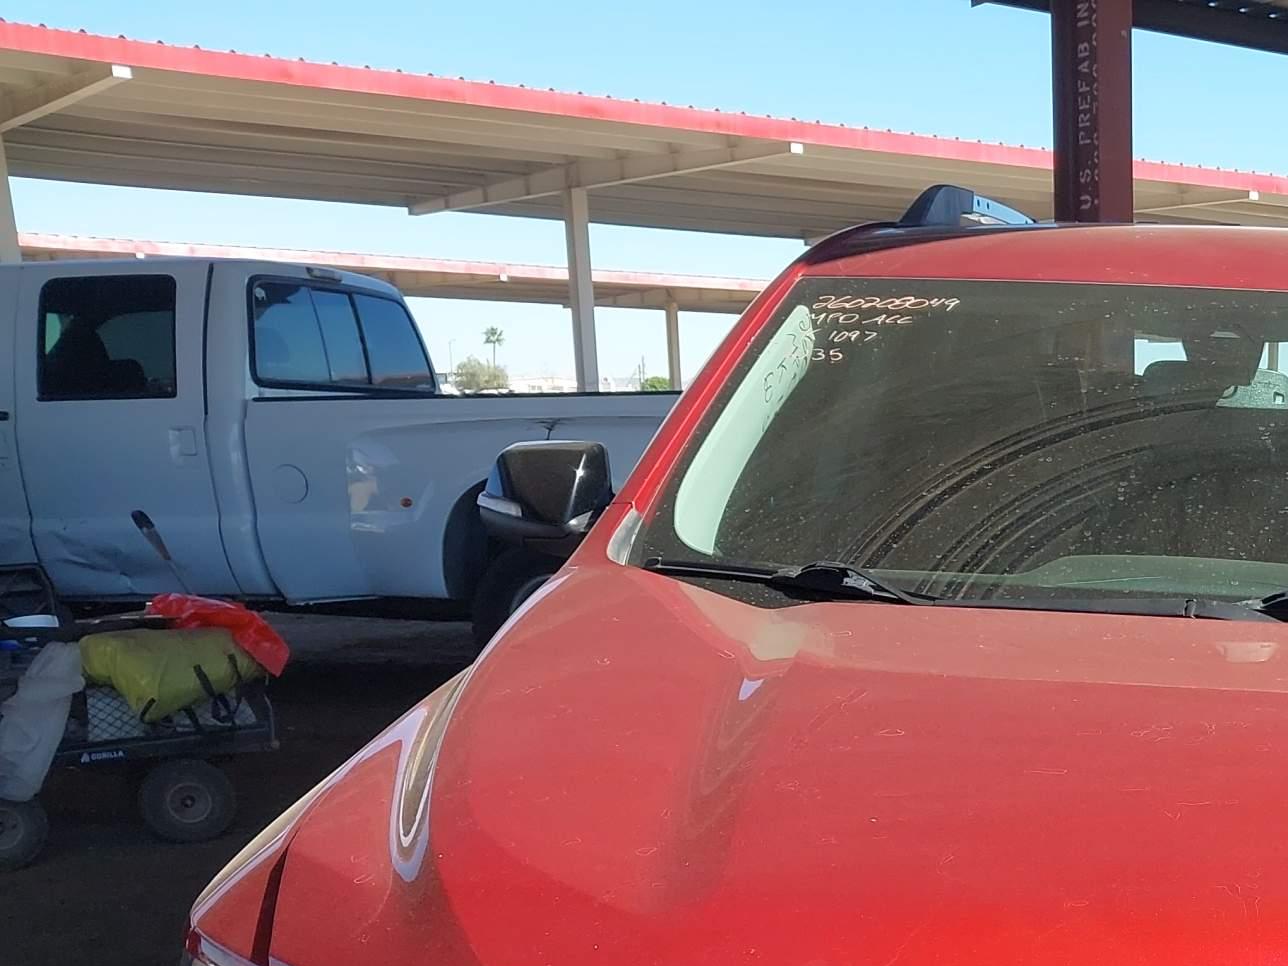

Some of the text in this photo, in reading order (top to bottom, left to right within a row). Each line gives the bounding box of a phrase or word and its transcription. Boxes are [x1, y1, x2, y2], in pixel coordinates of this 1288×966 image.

[1077, 41, 1092, 146] PREFAB
[1078, 161, 1092, 211] U.S.
[828, 329, 878, 344] 1097
